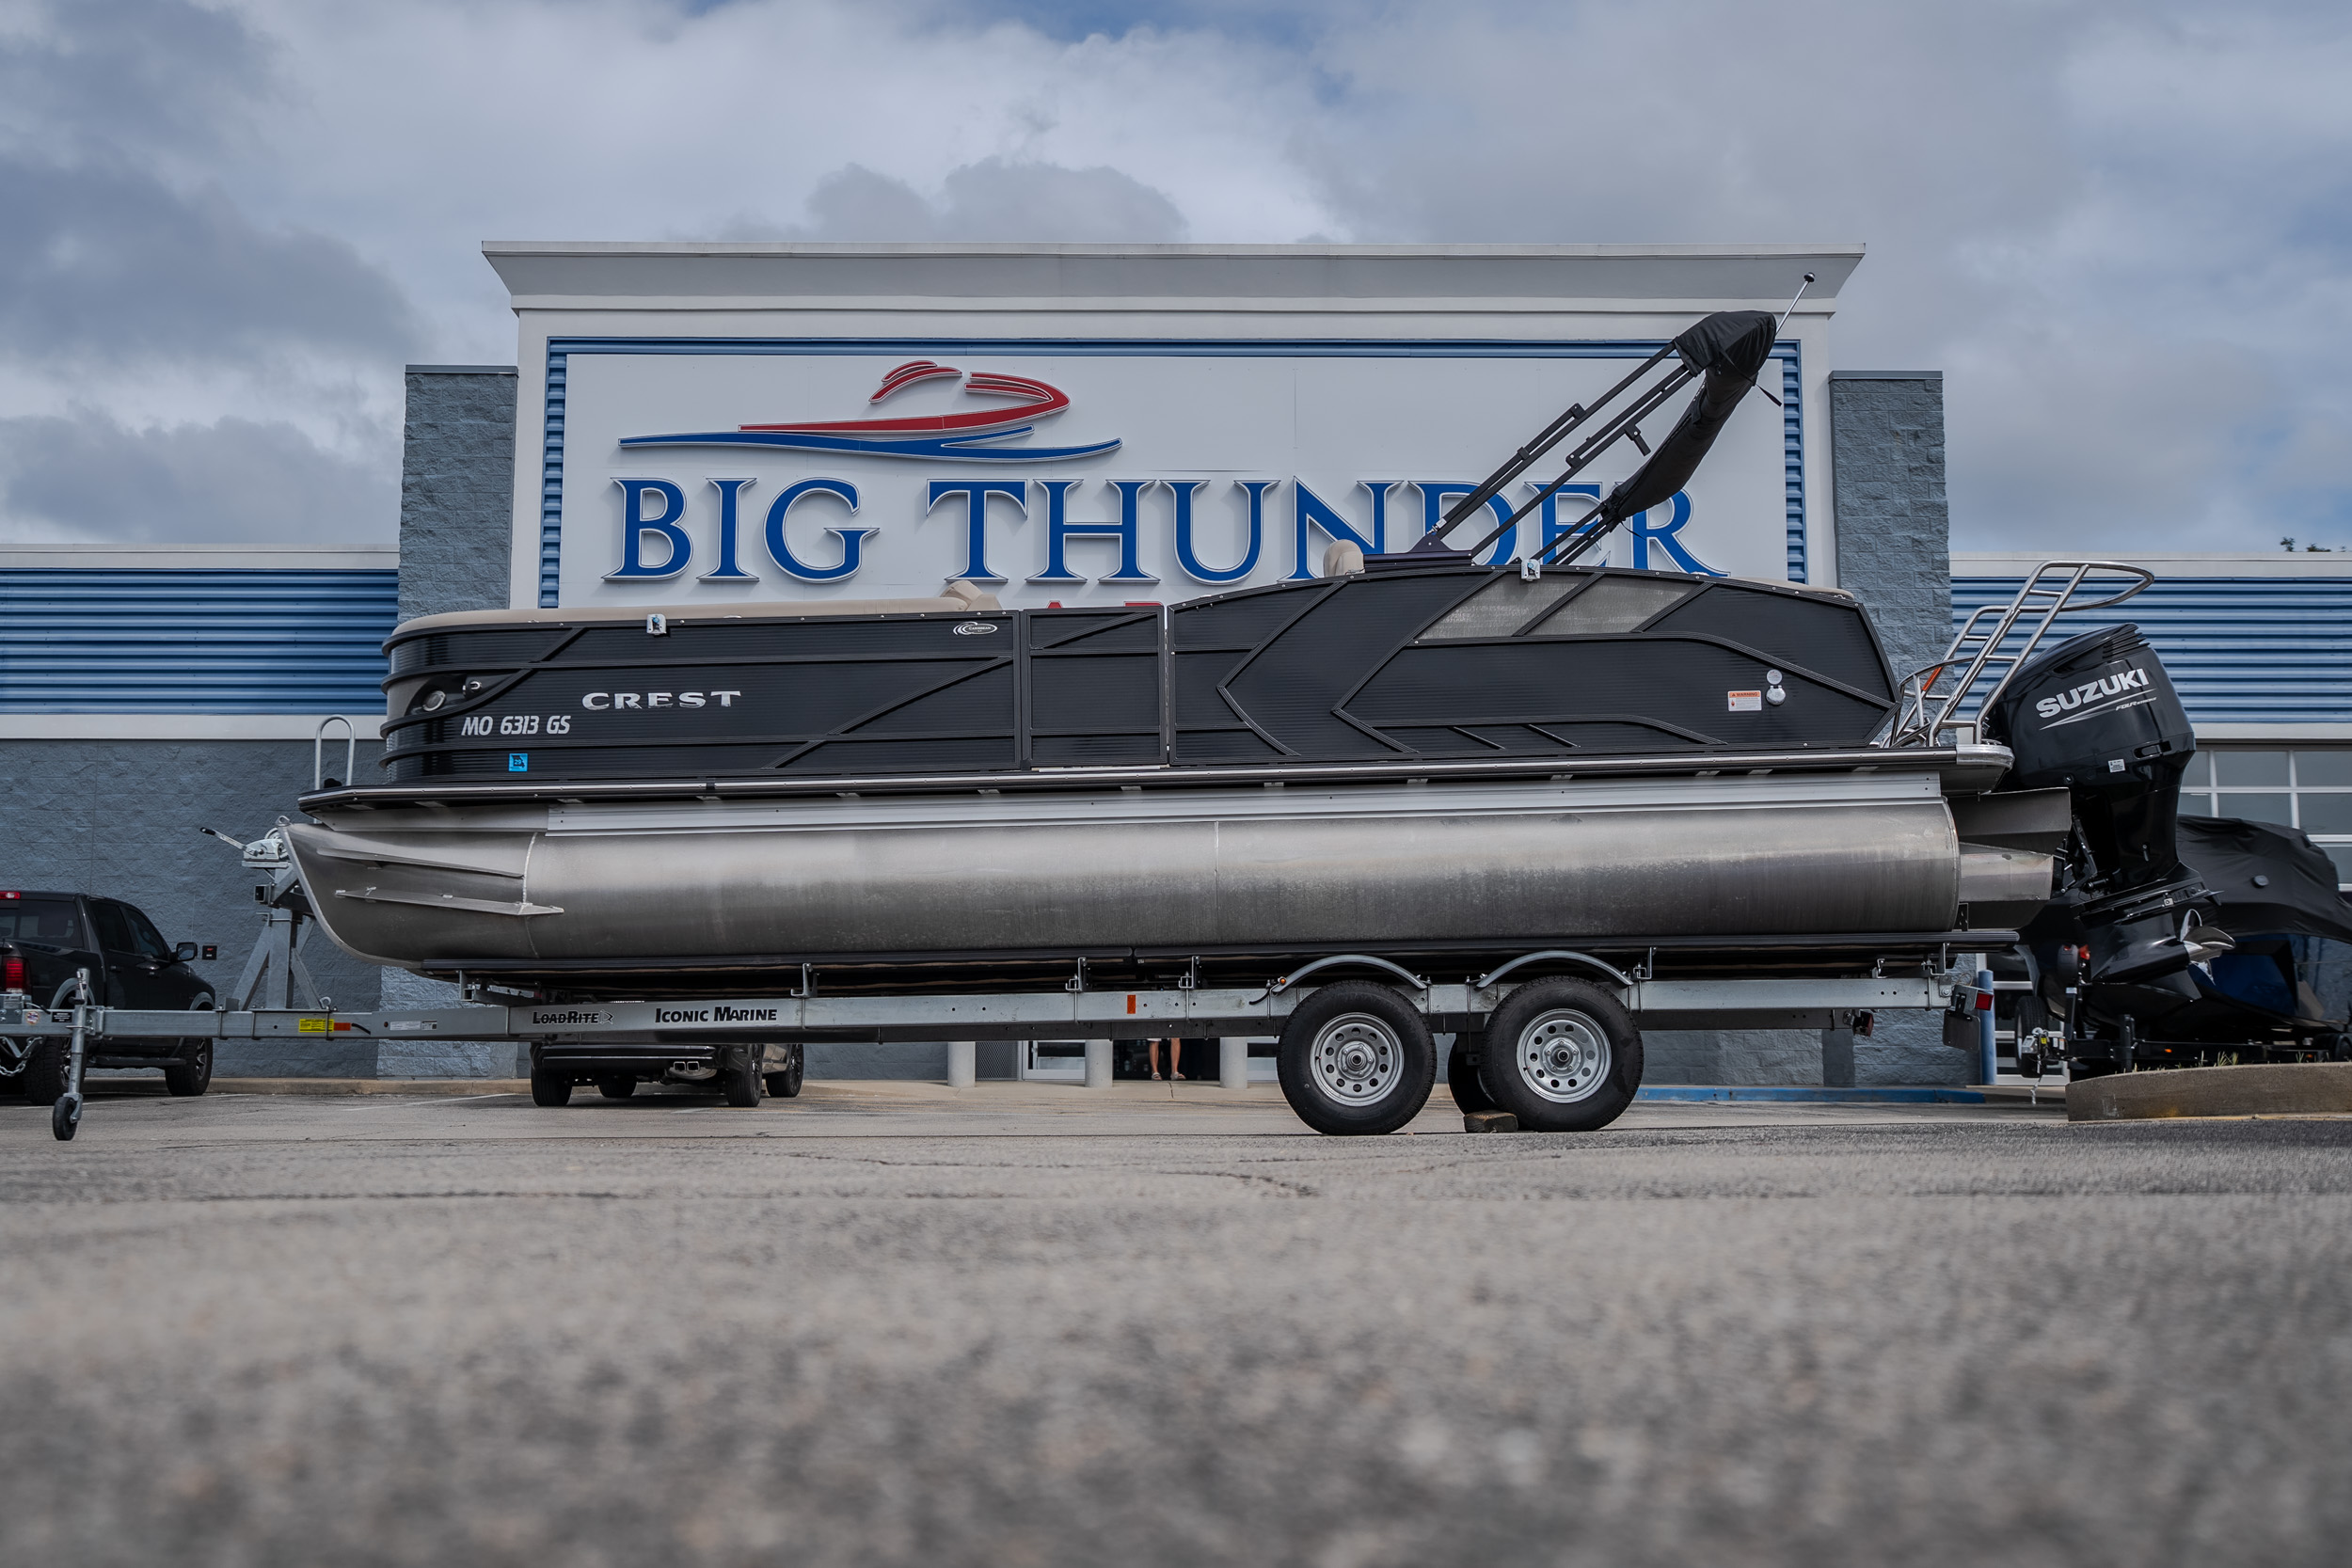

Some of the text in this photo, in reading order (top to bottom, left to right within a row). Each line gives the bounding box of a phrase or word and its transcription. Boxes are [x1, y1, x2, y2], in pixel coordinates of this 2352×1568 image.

[600, 475, 1732, 585] BIG THUNDER
[581, 690, 741, 710] CREST
[2036, 668, 2150, 718] SUZUKI
[2115, 701, 2137, 711] FOUR
[461, 715, 571, 736] MO 6313 GS
[655, 1006, 778, 1023] ICONIC MARINE
